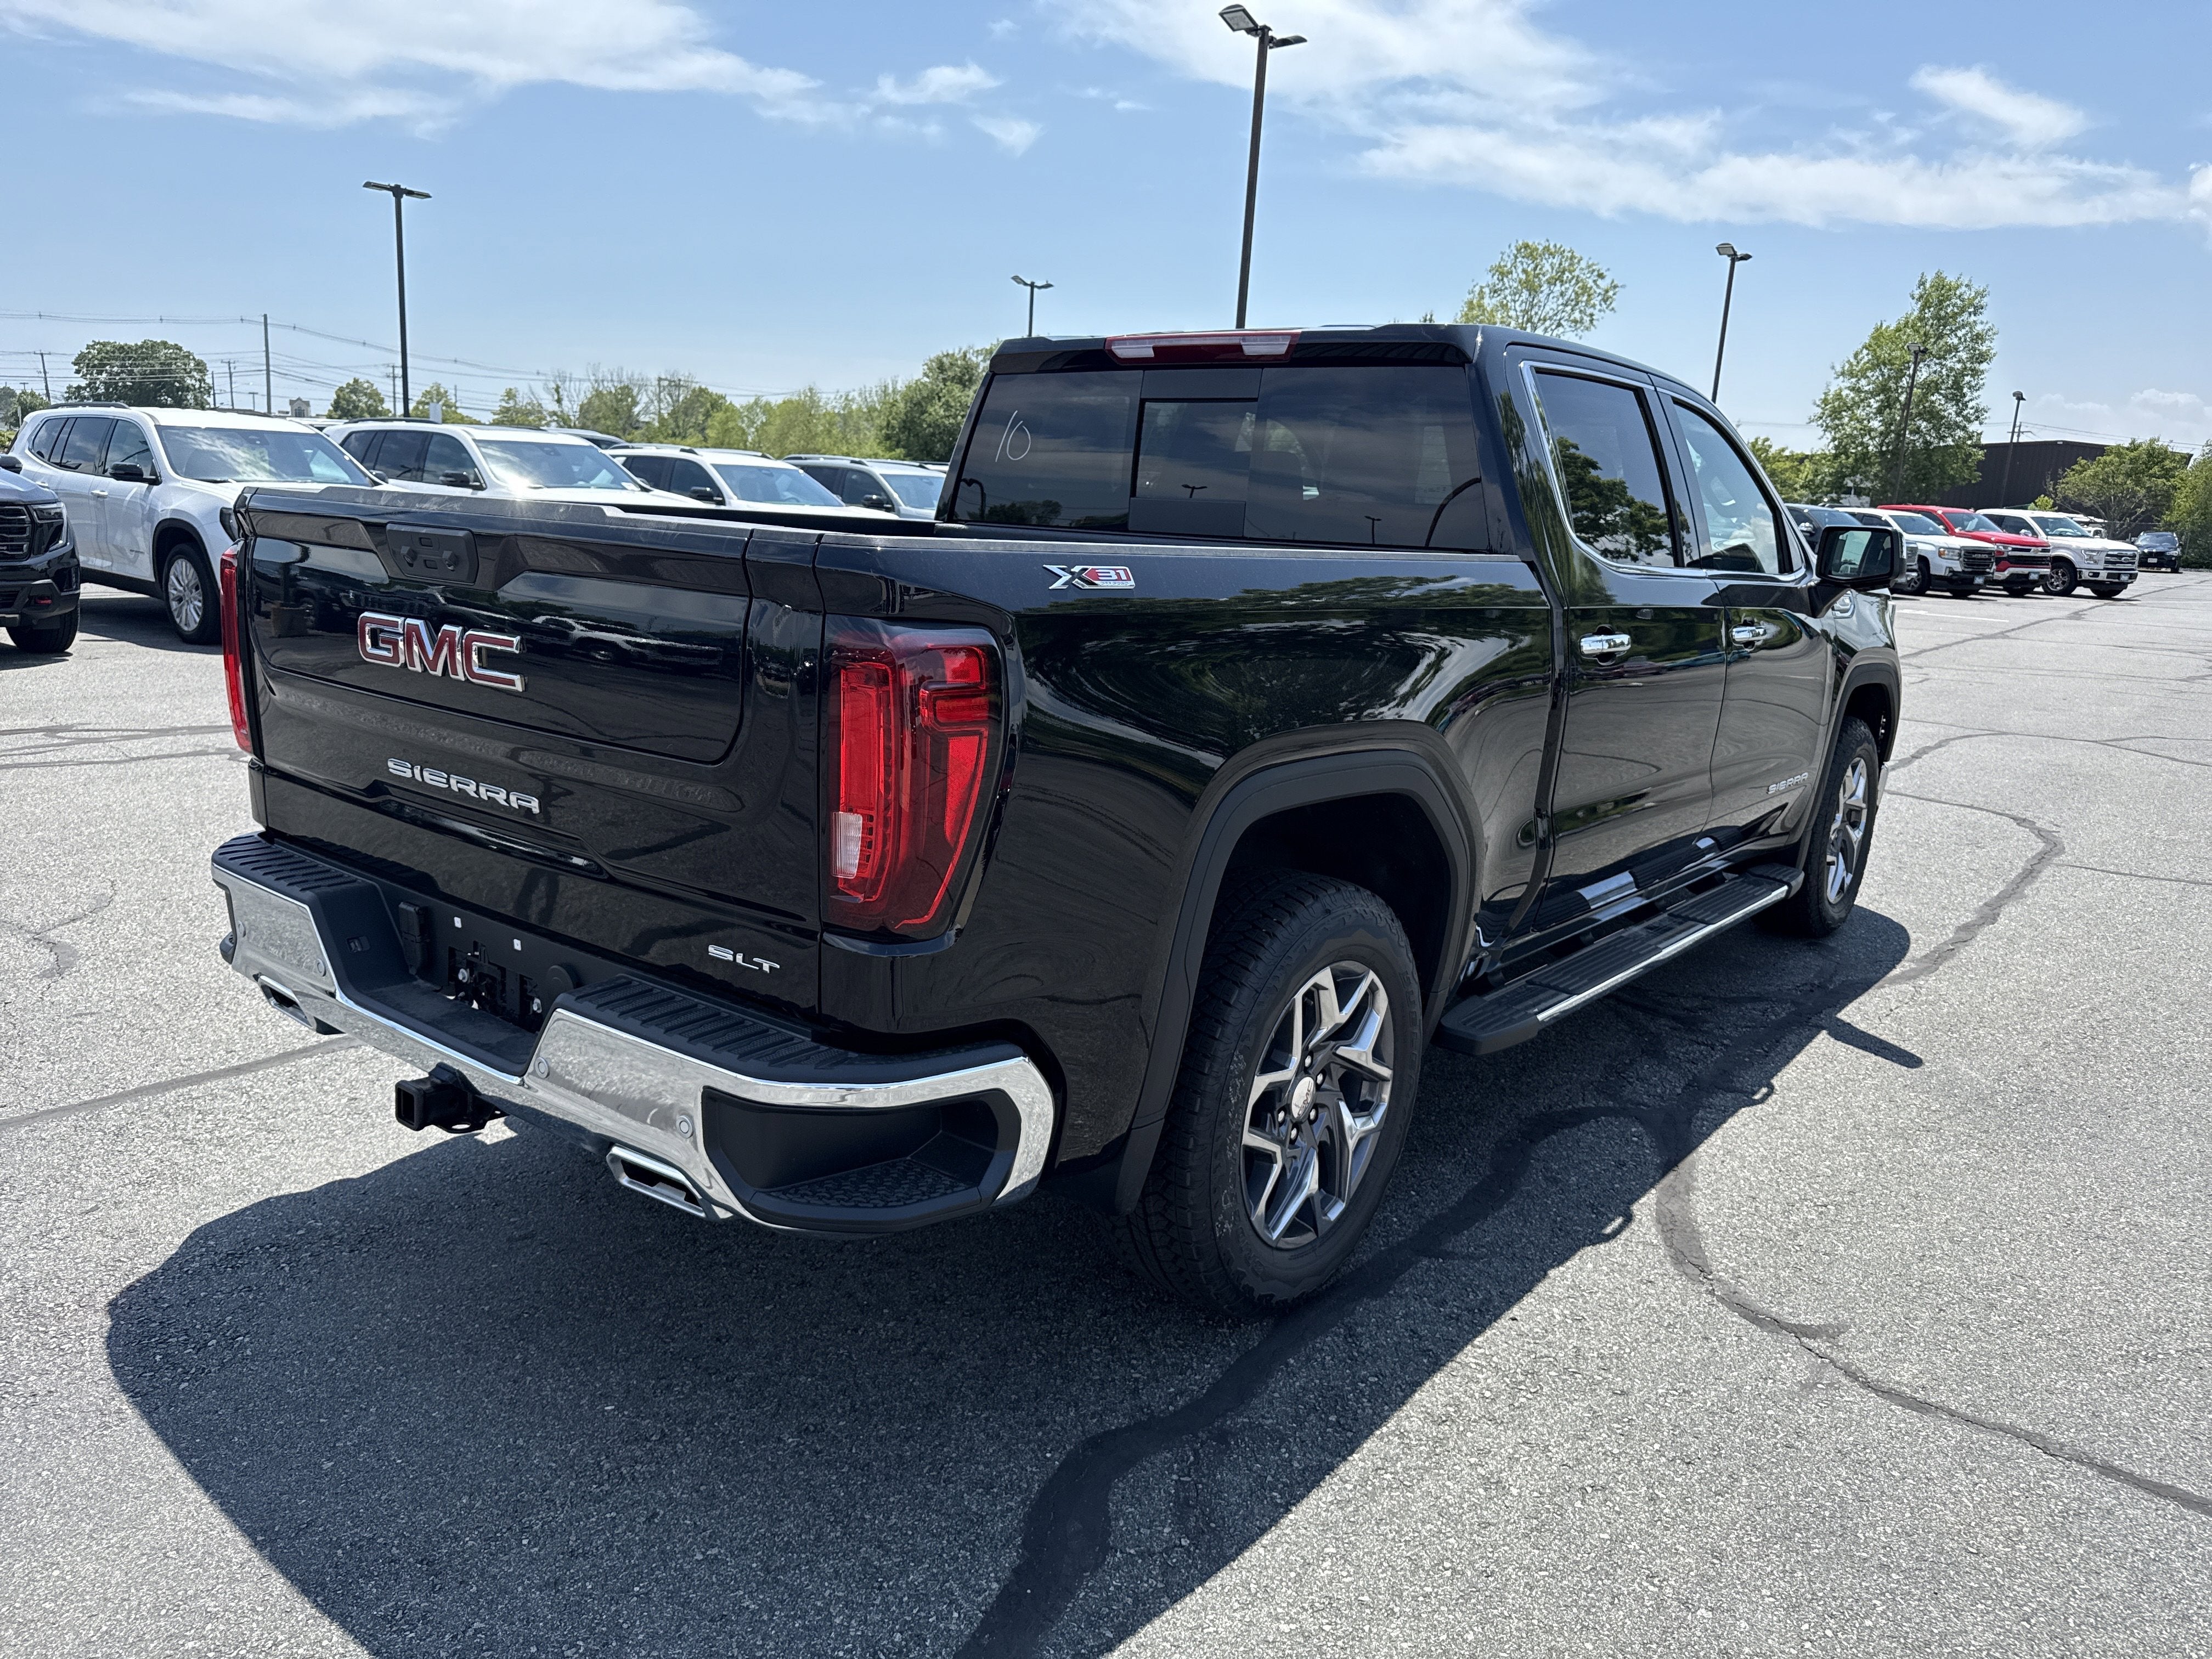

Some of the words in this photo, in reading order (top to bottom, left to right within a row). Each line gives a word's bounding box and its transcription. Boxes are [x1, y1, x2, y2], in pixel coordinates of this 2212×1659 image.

[995, 410, 1031, 462] 10
[358, 612, 527, 692] GMC
[387, 758, 541, 814] SIERRA
[1767, 772, 1809, 794] SIERRA
[708, 945, 780, 973] SLT
[1297, 1080, 1313, 1116] GMC
